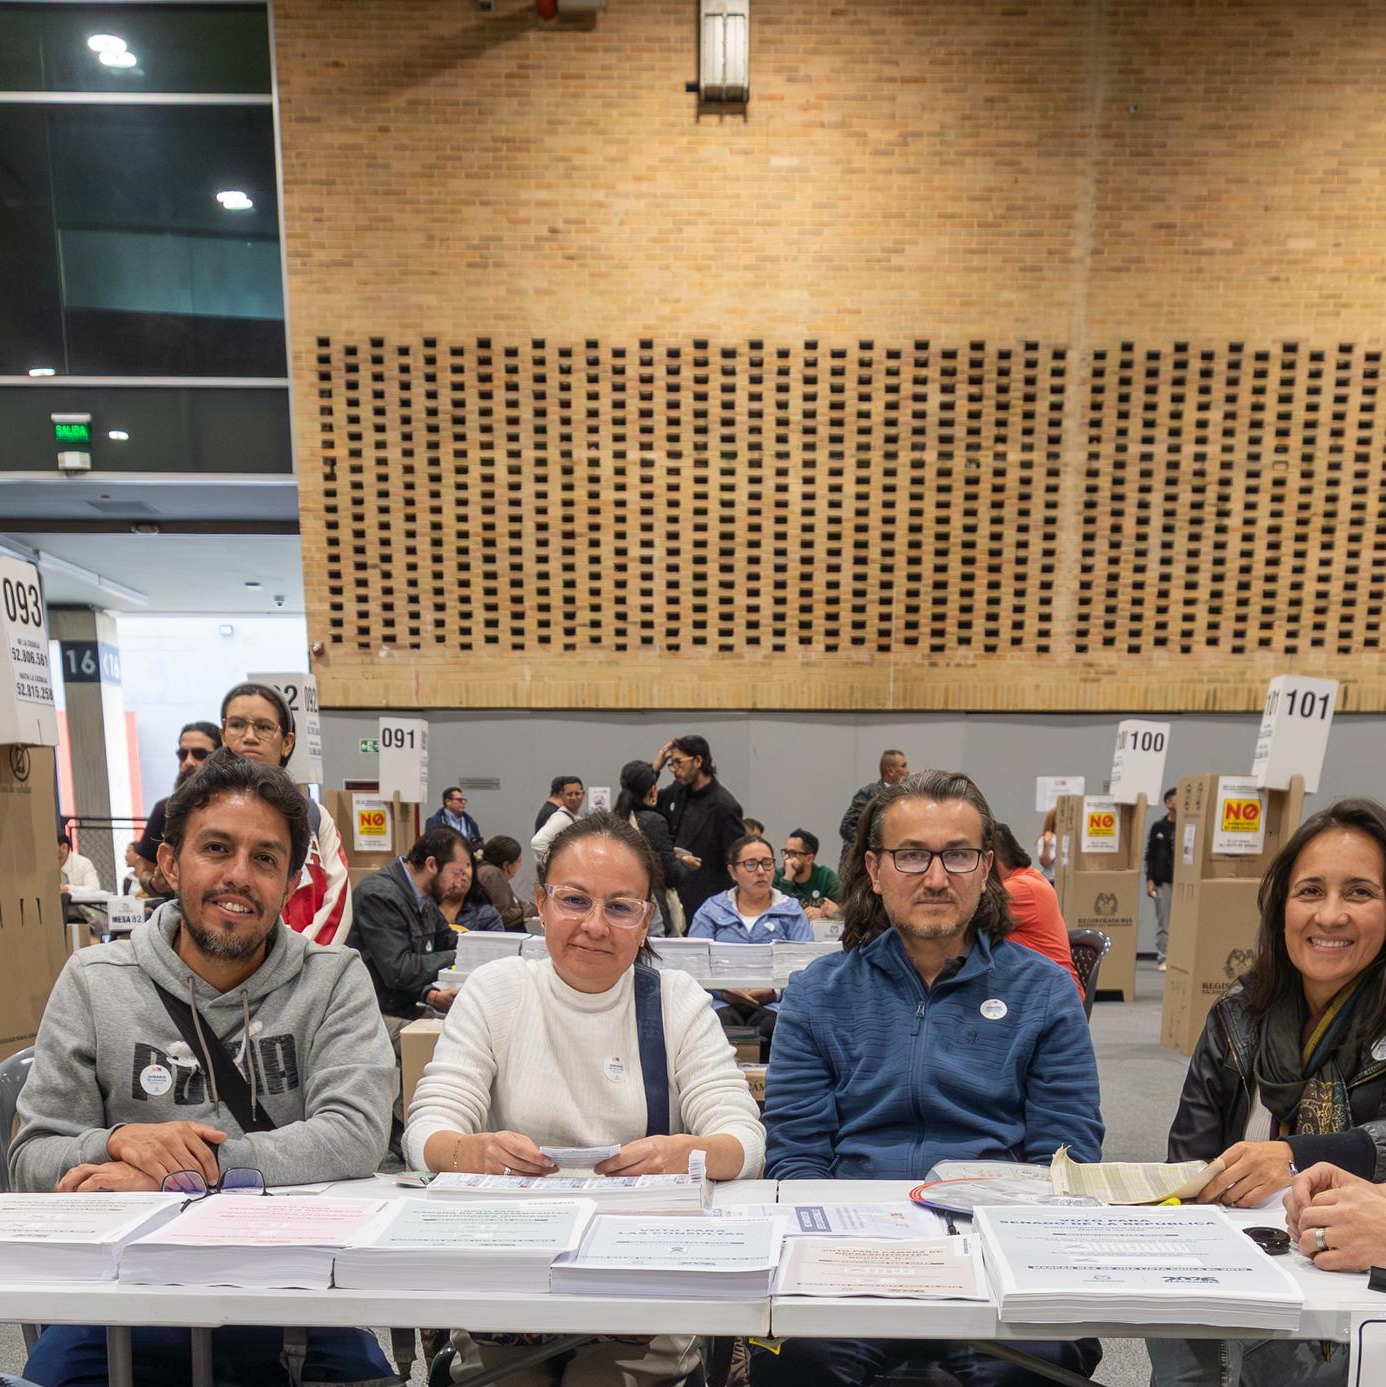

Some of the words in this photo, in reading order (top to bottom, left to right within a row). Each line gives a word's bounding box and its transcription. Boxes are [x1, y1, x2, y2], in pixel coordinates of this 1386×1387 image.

[55, 424, 89, 440] SALIDA
[3, 577, 42, 627] 093
[66, 649, 96, 675] 16
[1286, 689, 1330, 719] 101
[382, 727, 416, 749] 091
[1131, 731, 1165, 752] 100
[360, 813, 385, 827] NO
[1225, 803, 1259, 820] NO
[1090, 815, 1115, 828] NO
[132, 915, 142, 923] 82
